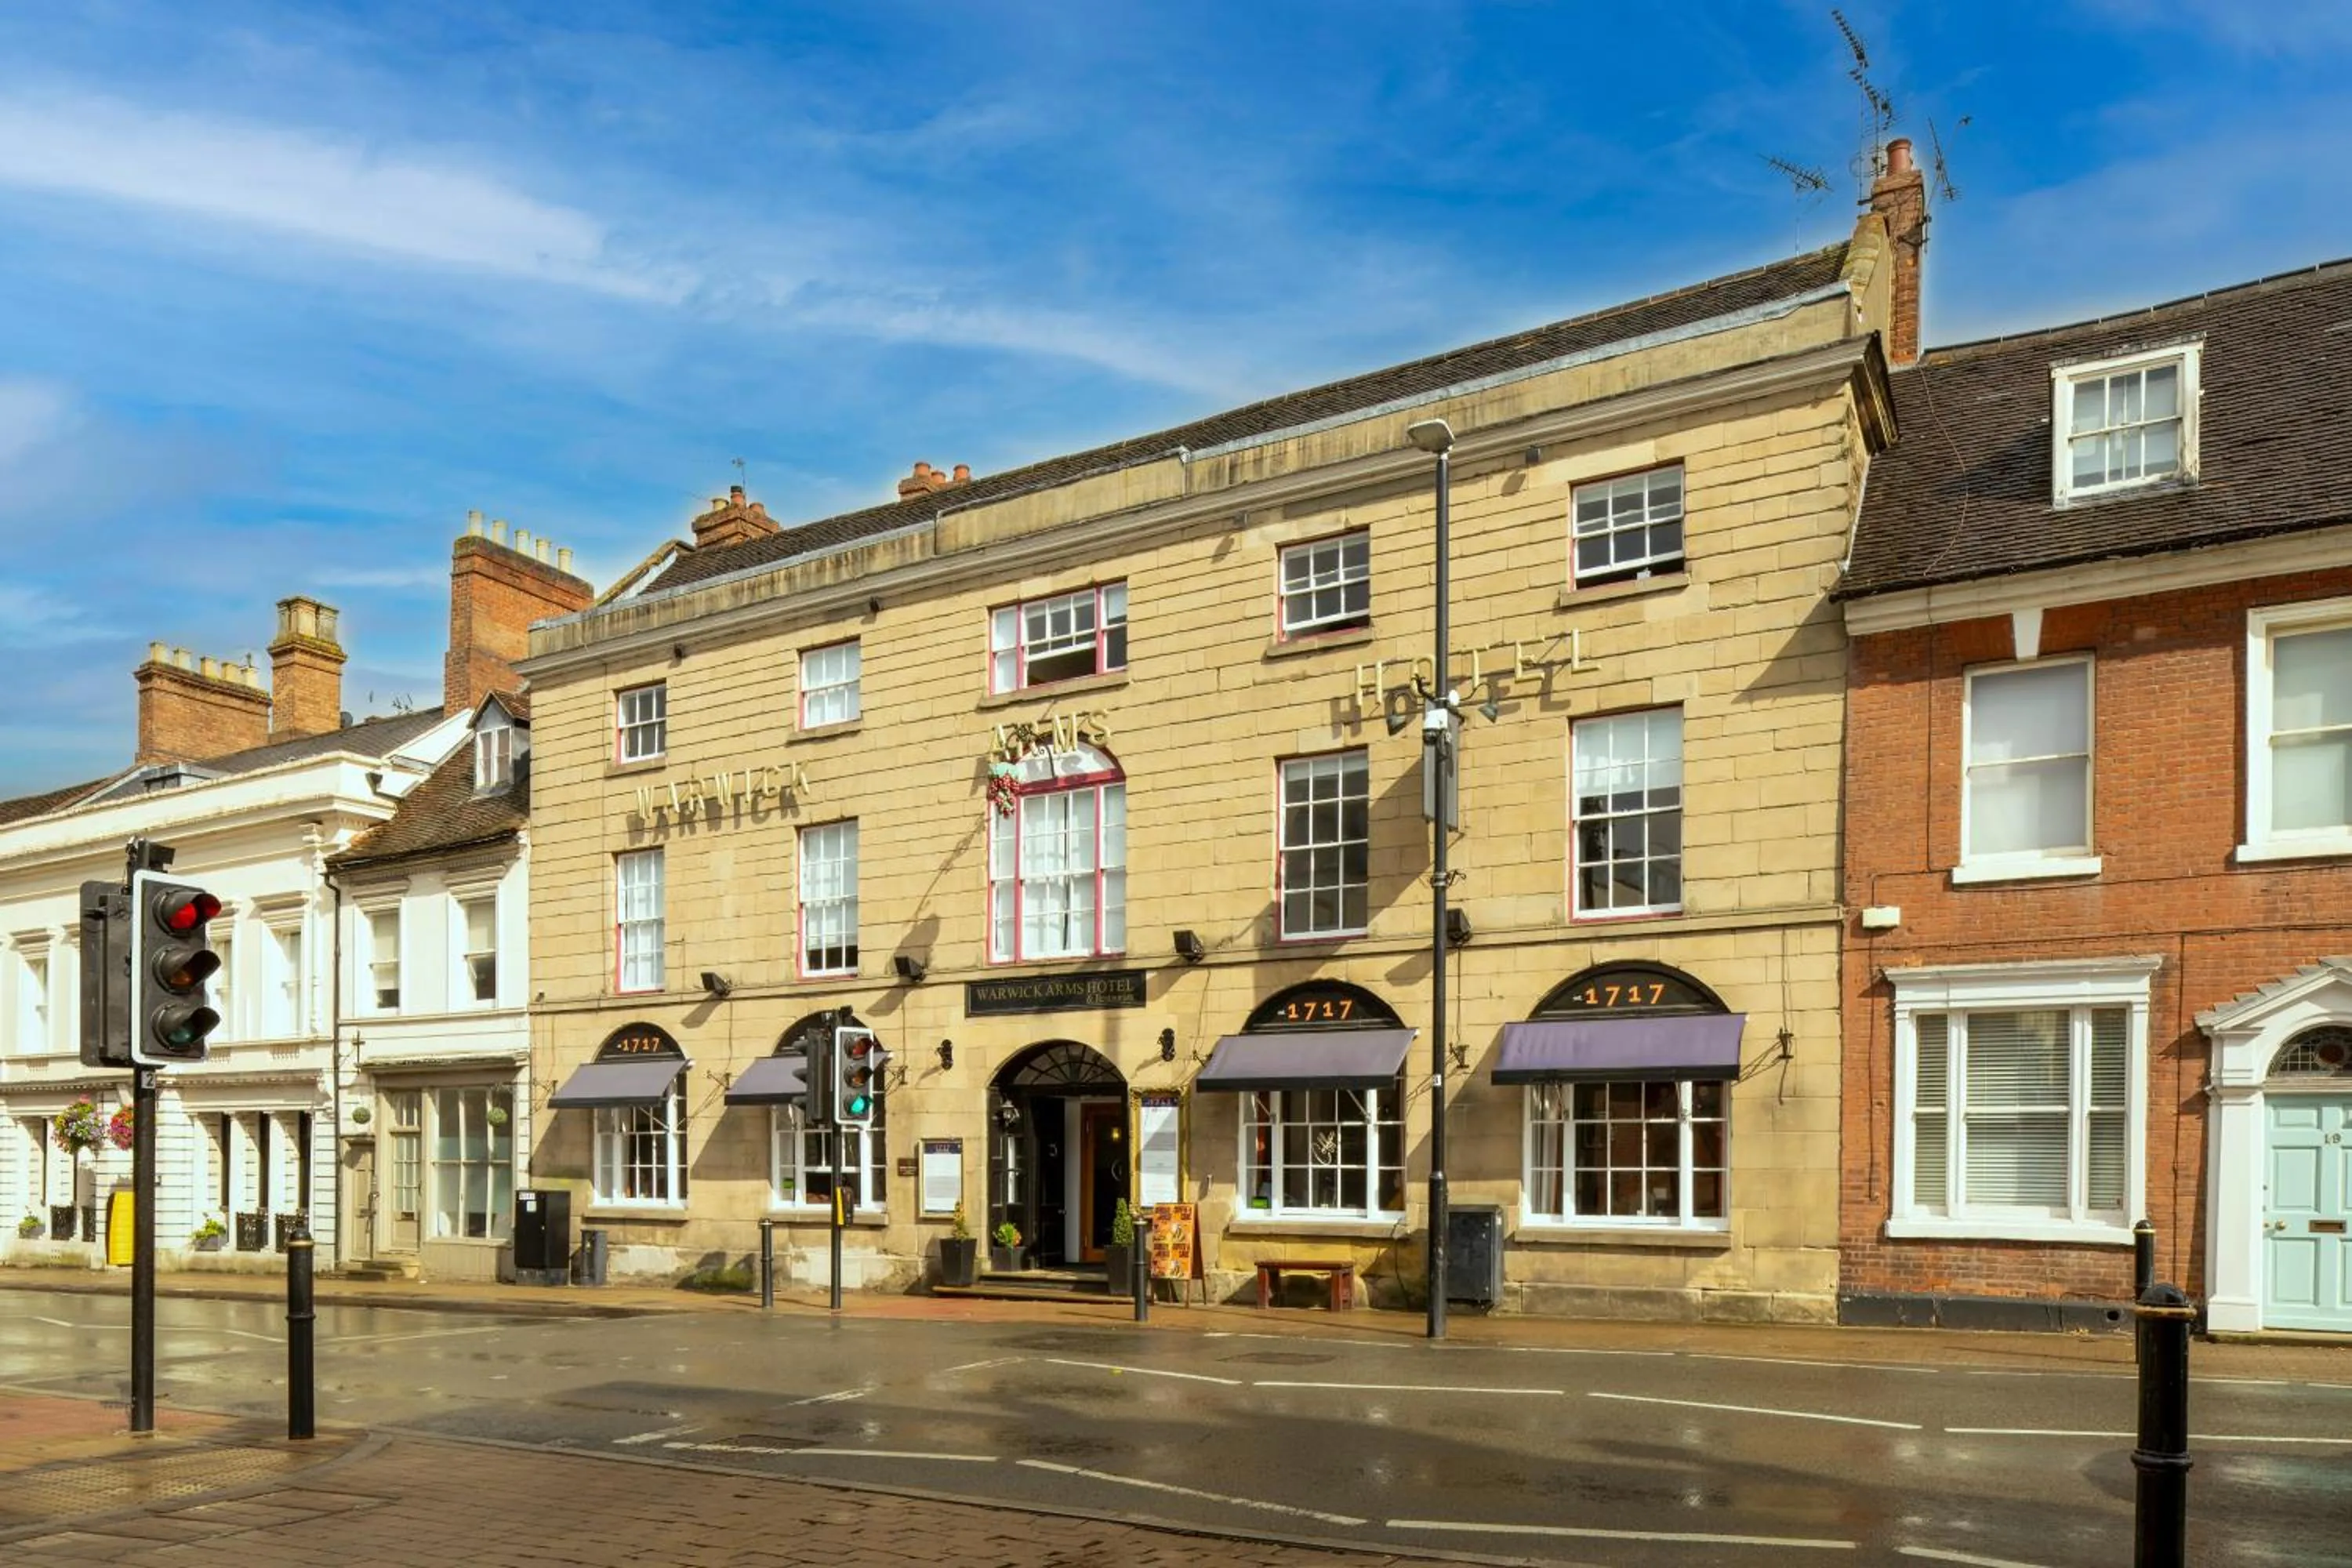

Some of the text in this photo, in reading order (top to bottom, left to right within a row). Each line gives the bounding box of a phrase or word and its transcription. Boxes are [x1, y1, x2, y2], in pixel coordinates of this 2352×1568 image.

[1356, 627, 1602, 706] HOTEL
[989, 709, 1111, 763] ARMS
[637, 759, 809, 820] WARWICK
[977, 978, 1134, 1001] WARWICK ARMS HOTEL
[1585, 984, 1664, 1007] 1717
[1287, 1000, 1352, 1021] 1717
[622, 1036, 660, 1052] 1717
[147, 1073, 154, 1087] 2
